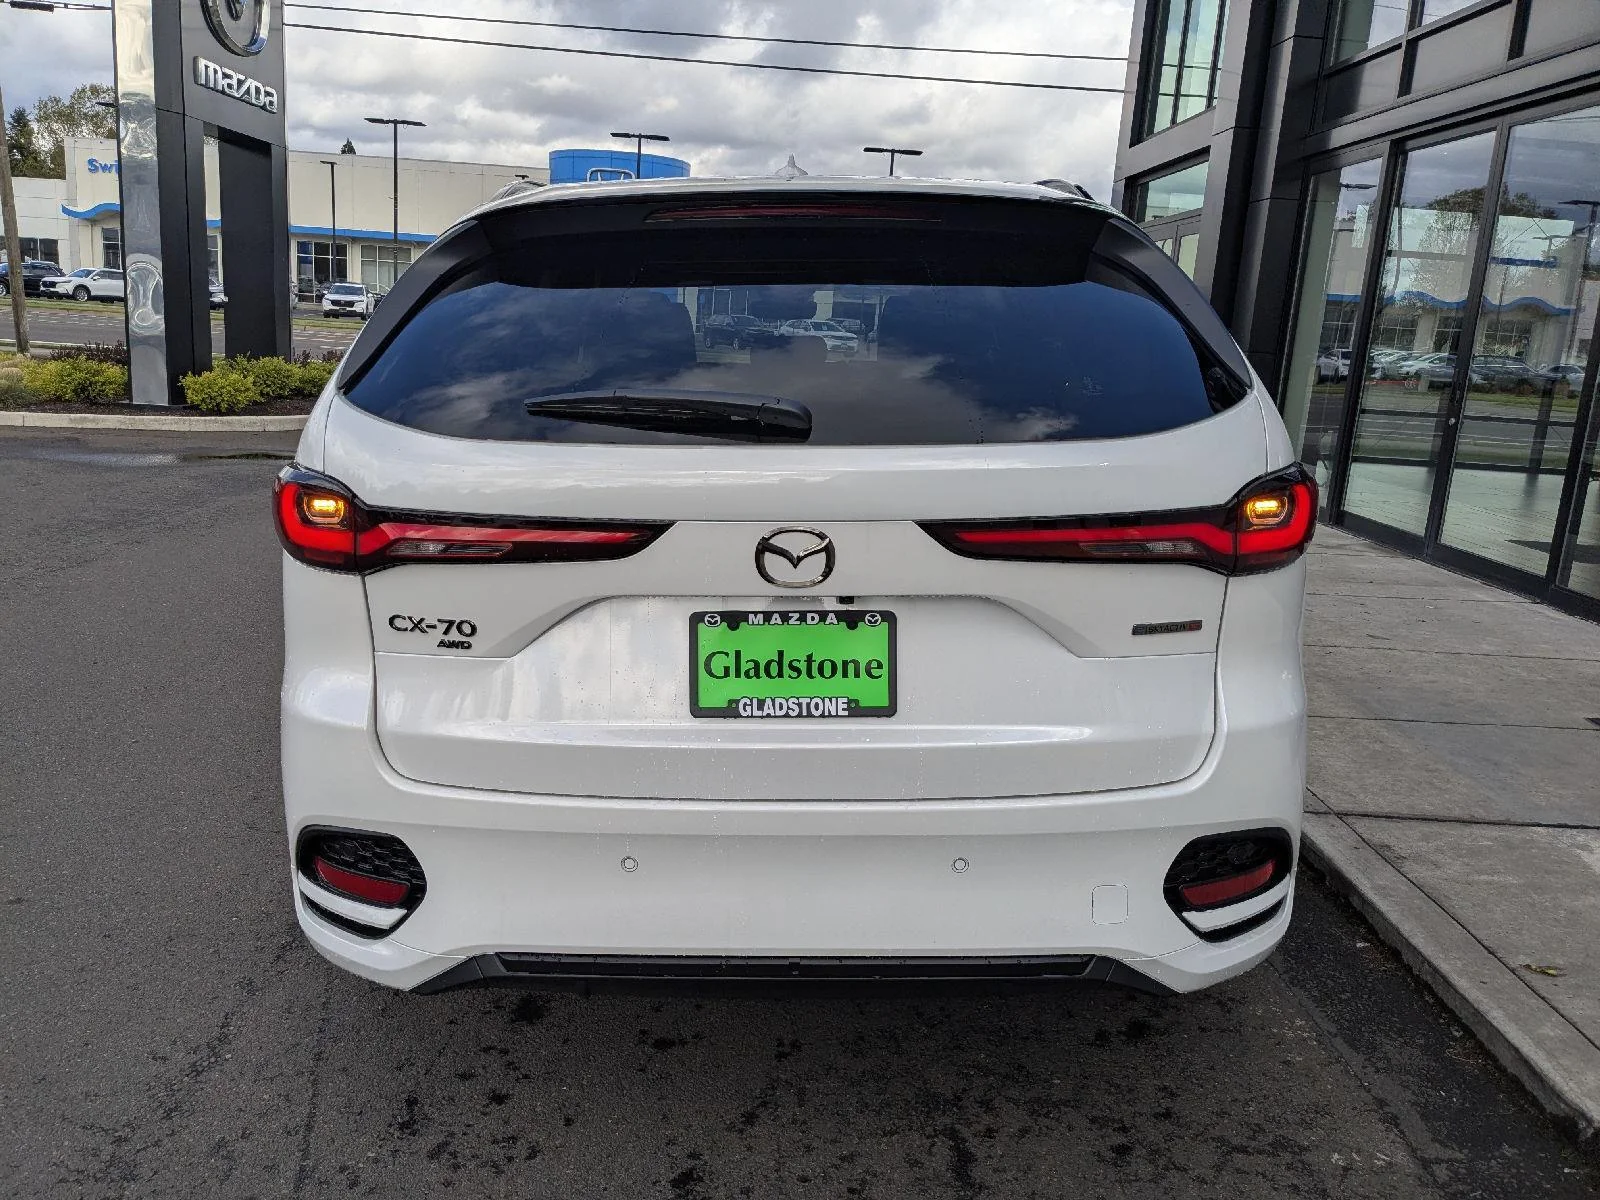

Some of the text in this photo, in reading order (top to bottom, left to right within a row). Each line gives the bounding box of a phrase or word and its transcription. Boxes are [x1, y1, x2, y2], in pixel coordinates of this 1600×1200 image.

[388, 614, 478, 637] CX-70
[748, 613, 838, 625] MAZDA
[437, 639, 473, 650] AWD
[703, 649, 884, 680] Gladstone
[738, 697, 849, 717] GLADSTONE
